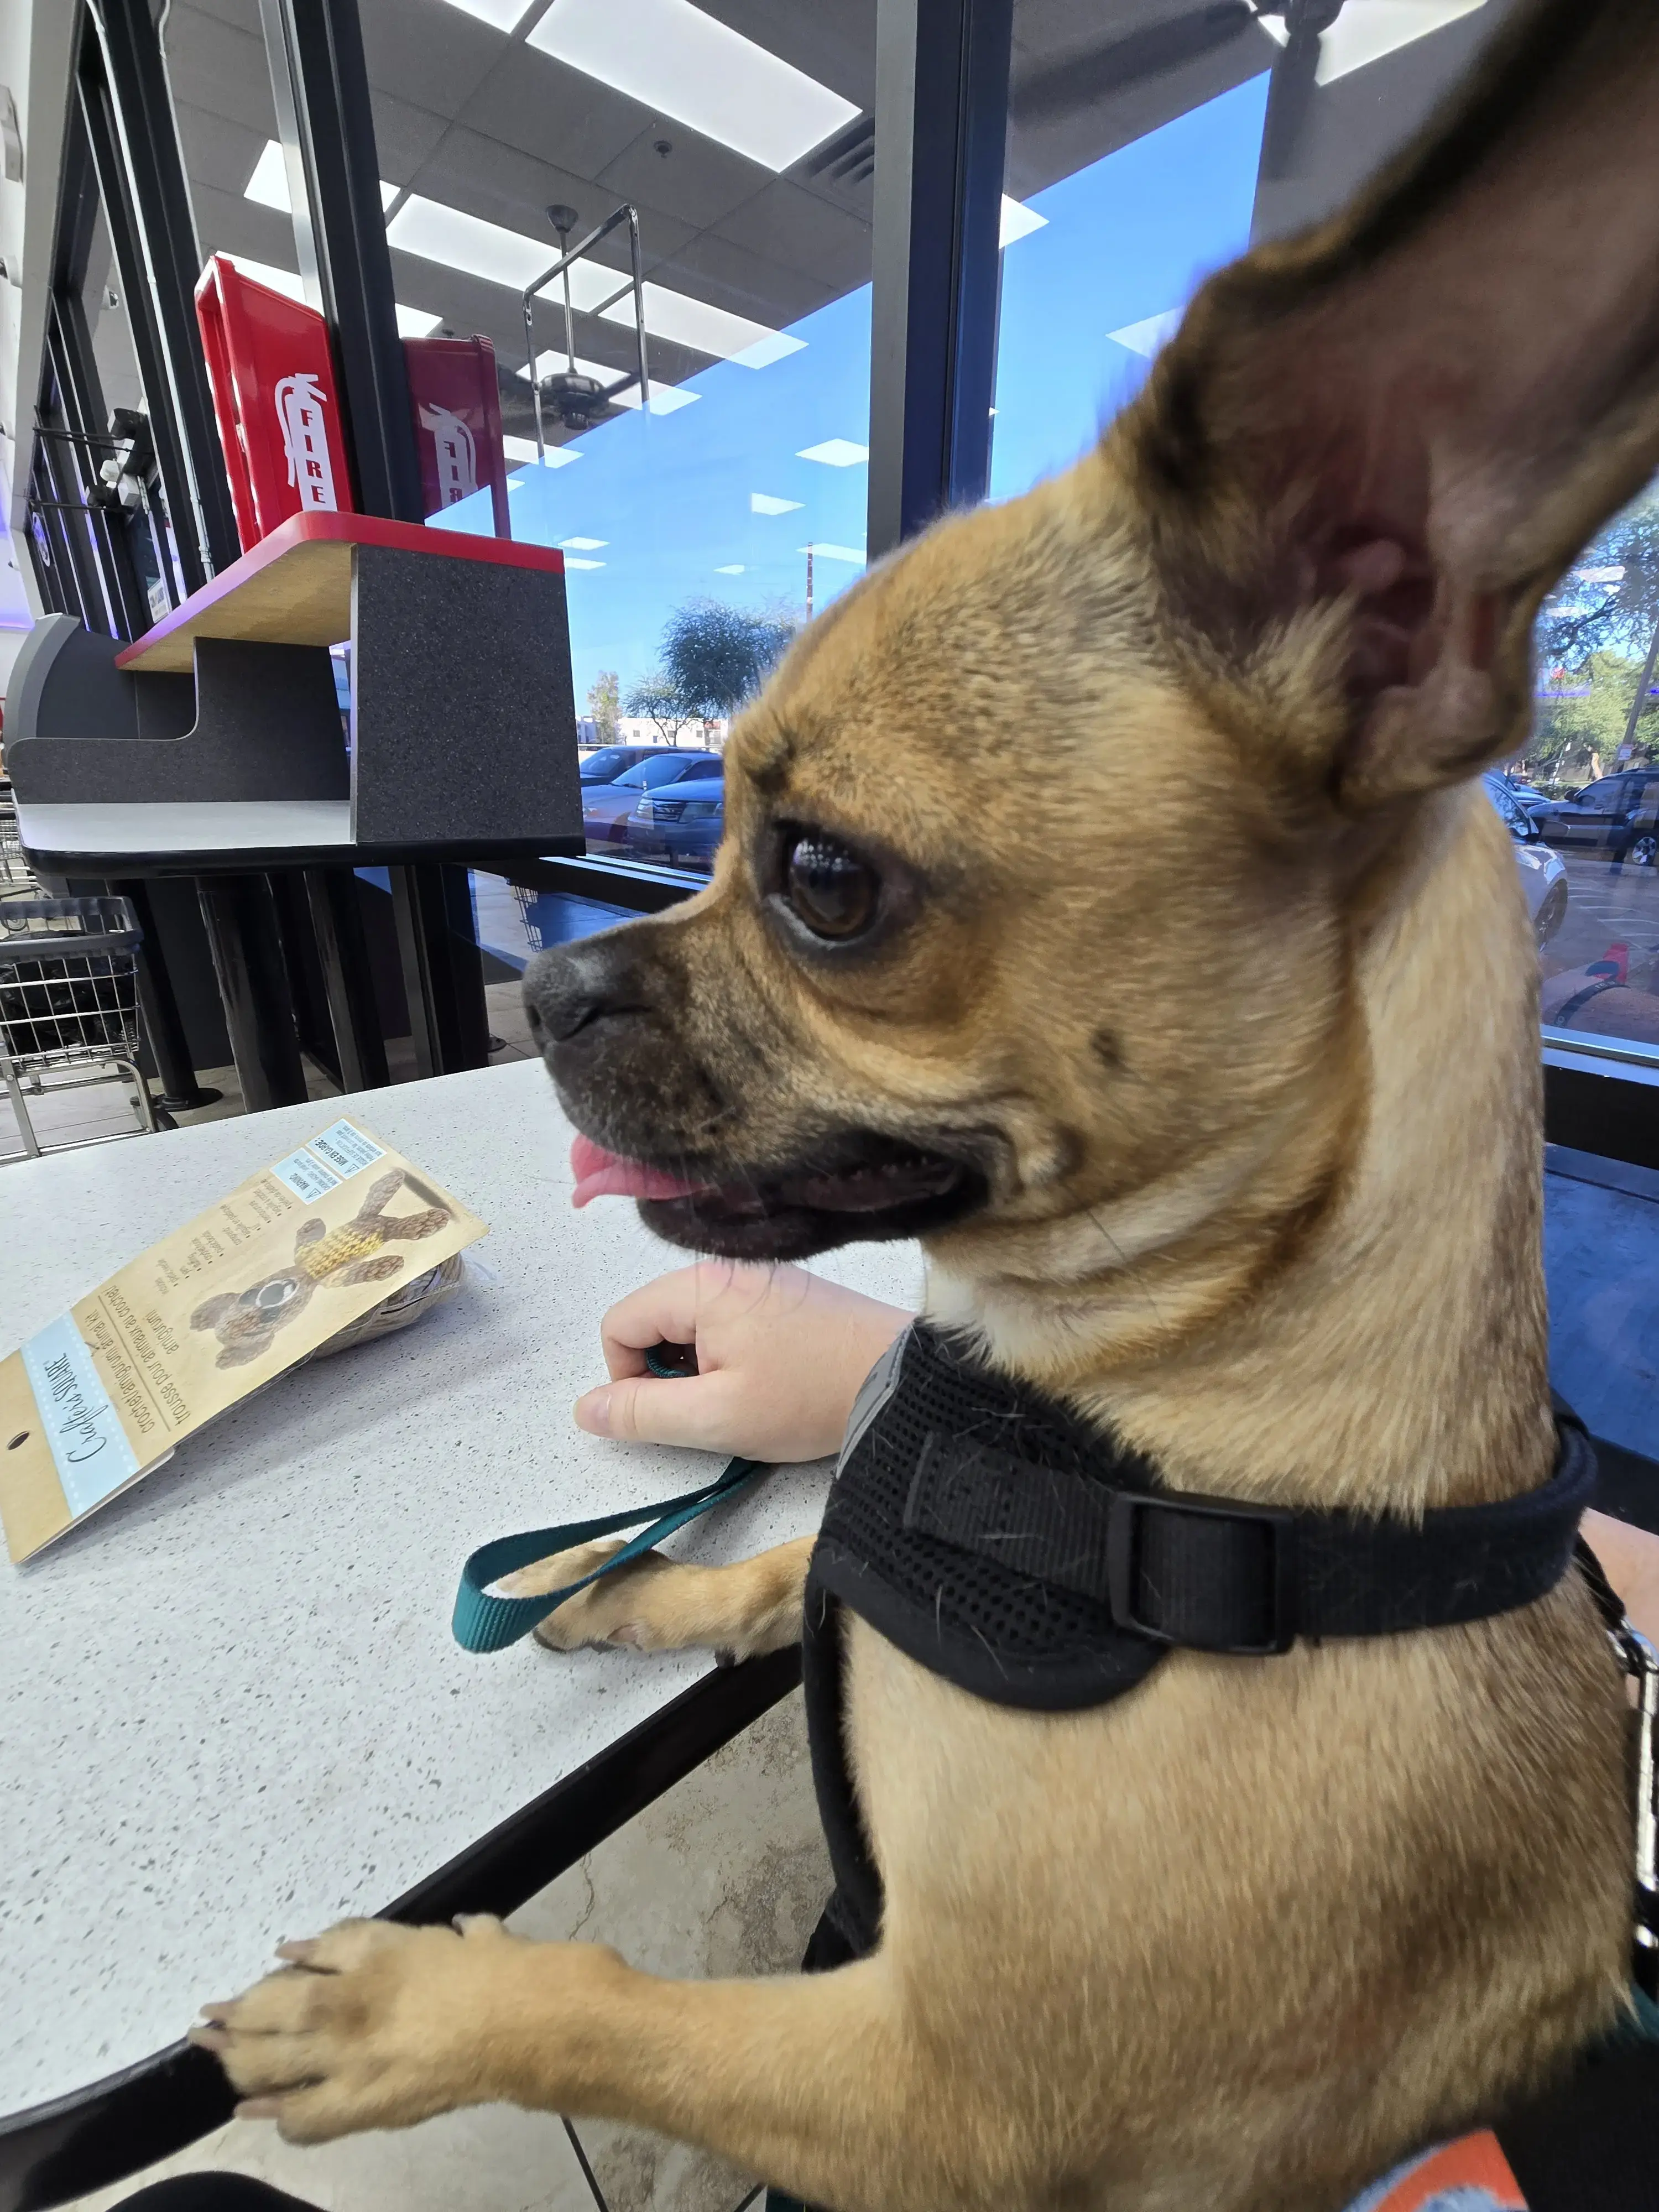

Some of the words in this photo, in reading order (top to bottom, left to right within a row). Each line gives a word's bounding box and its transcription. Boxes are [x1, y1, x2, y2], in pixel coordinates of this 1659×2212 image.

[300, 408, 326, 504] FIRE
[328, 1150, 340, 1159] EN
[332, 1154, 348, 1166] MISE
[85, 1310, 100, 1327] kit
[88, 1321, 113, 1350] animal
[123, 1315, 137, 1328] au
[142, 1310, 179, 1354] amigurumi
[128, 1325, 155, 1363] animaux
[44, 1353, 78, 1402] SQUARE
[106, 1346, 155, 1433] crochet/amigurumi
[147, 1361, 172, 1386] pour
[160, 1383, 191, 1426] trousse
[59, 1394, 108, 1463] Crafter's
